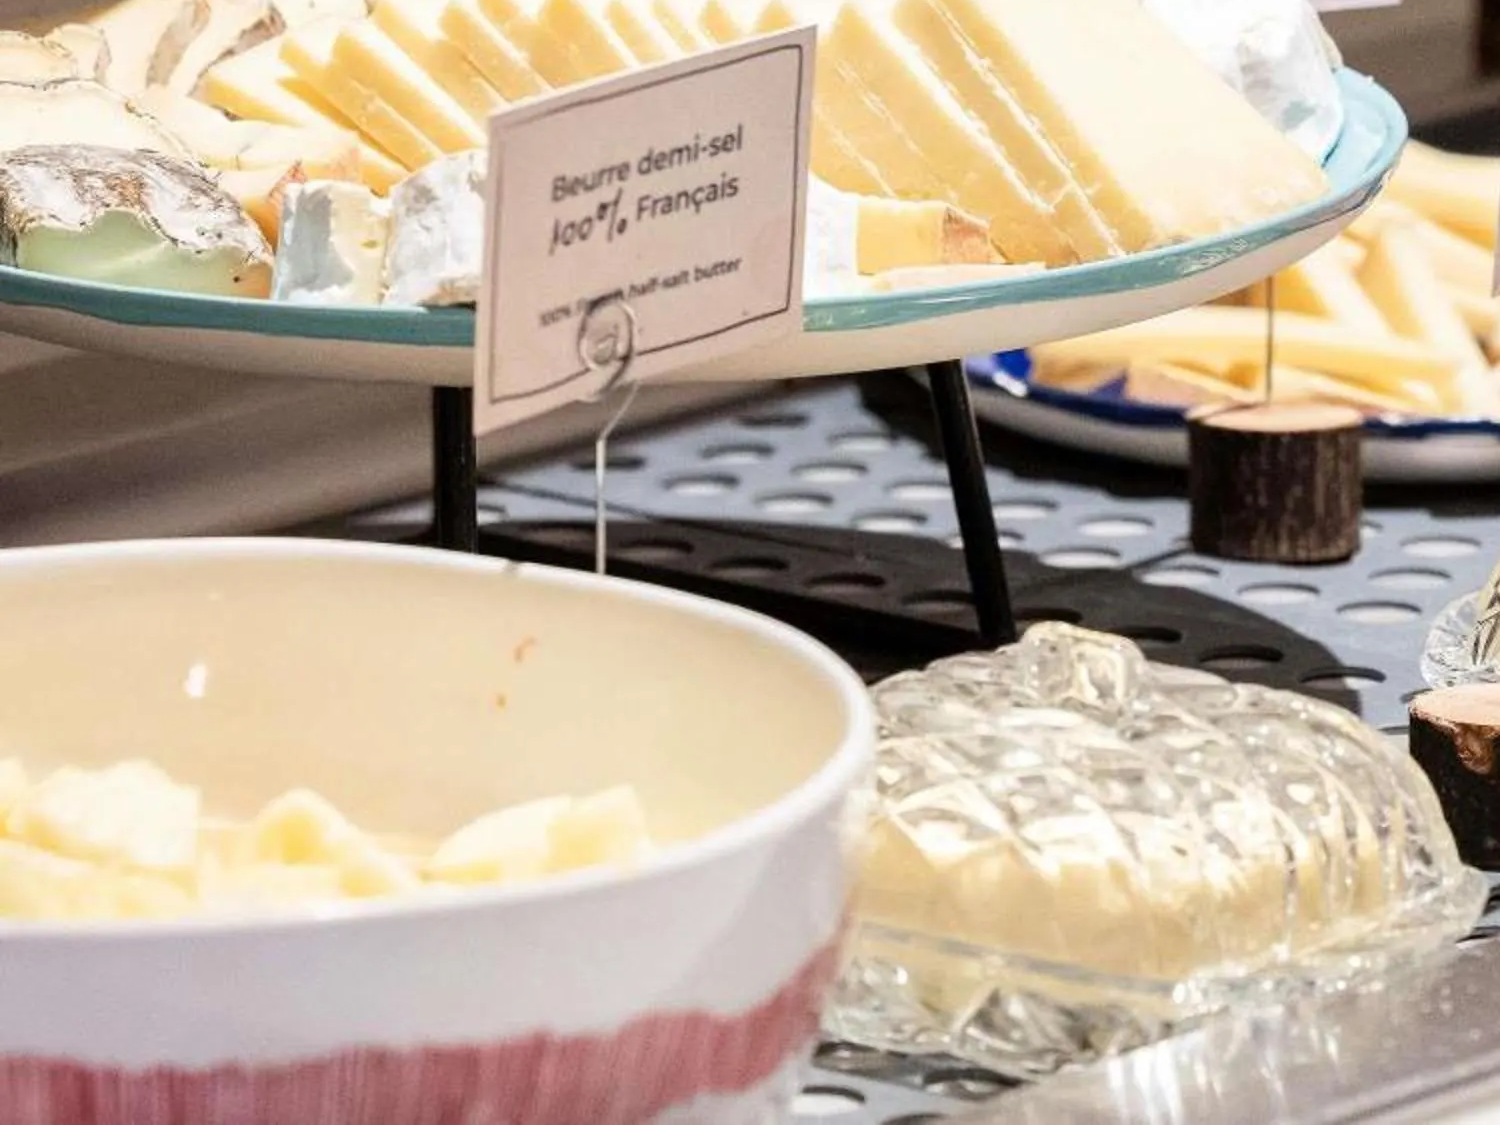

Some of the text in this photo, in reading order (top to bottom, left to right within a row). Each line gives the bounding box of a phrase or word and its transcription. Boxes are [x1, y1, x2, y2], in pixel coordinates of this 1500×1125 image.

[551, 124, 744, 203] Beurre demi-sel
[549, 172, 740, 255] 100% Français
[693, 257, 742, 283] butter
